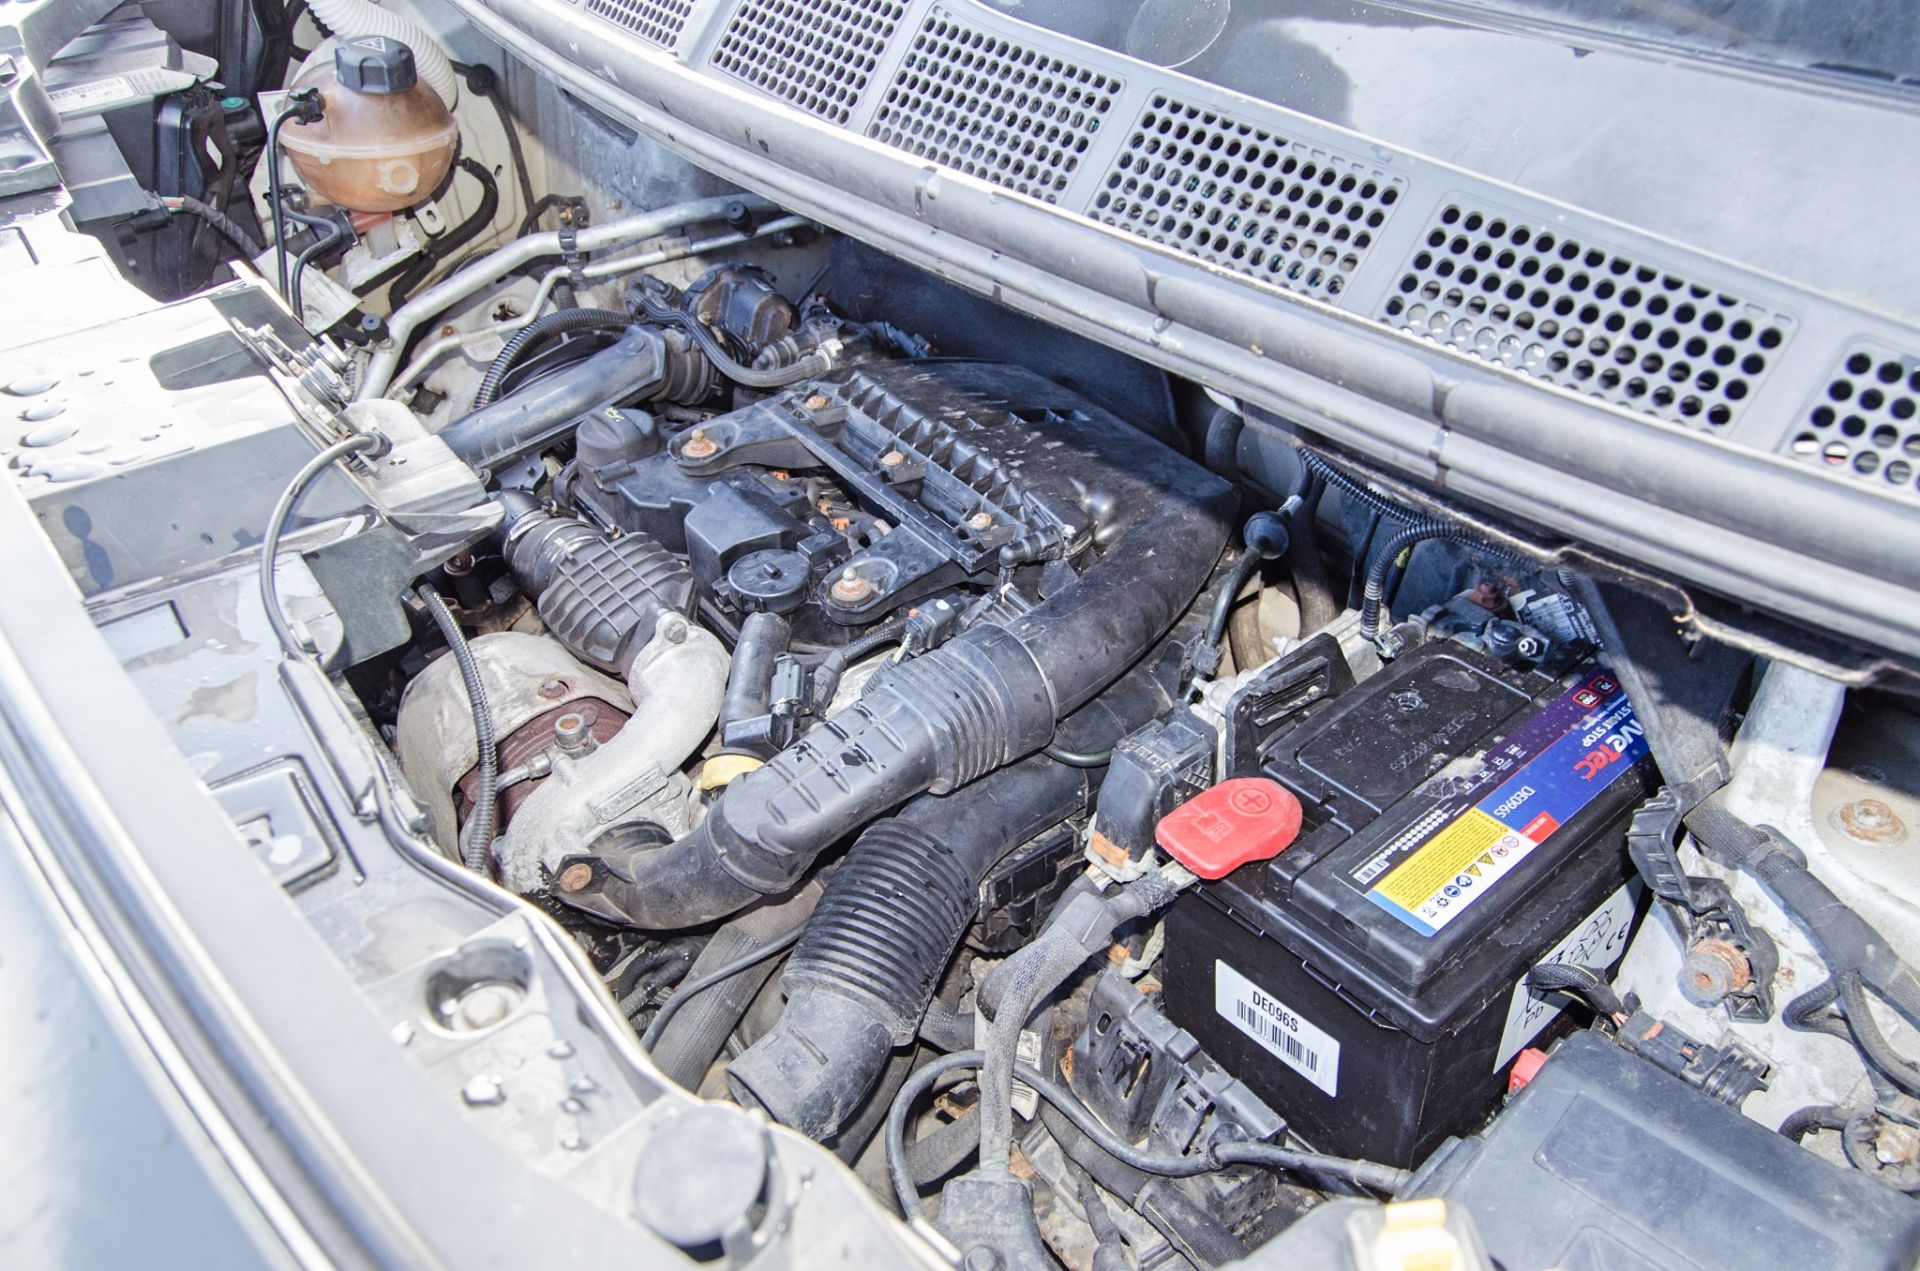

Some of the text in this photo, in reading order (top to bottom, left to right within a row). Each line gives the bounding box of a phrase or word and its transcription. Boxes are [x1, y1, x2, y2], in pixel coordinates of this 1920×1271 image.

[1582, 706, 1631, 747] START STOP
[1493, 786, 1536, 818] DE096S
[1606, 921, 1628, 950] CE
[1253, 990, 1298, 1032] DE096S
